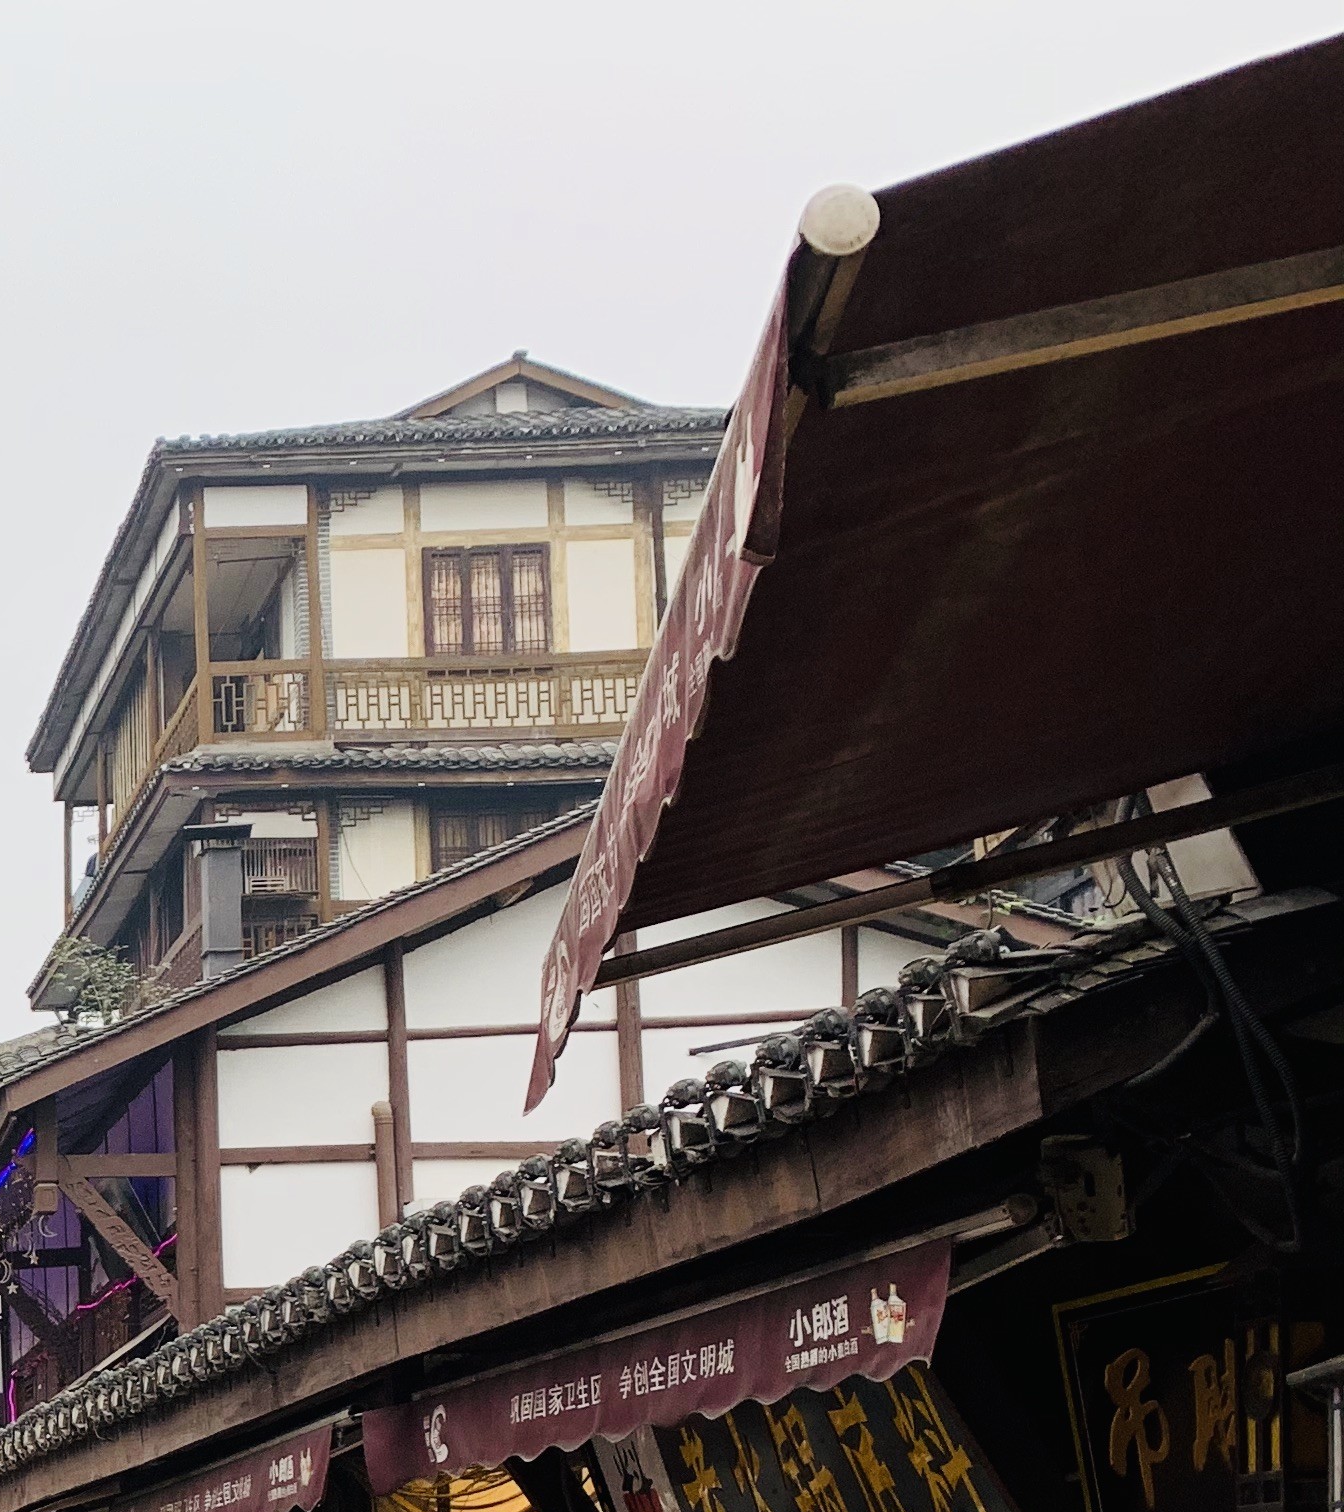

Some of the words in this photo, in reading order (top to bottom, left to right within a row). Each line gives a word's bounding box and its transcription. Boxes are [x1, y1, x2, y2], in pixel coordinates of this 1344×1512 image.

[789, 1294, 849, 1348] 小郎酒
[619, 1338, 735, 1400] 争创全国文明城
